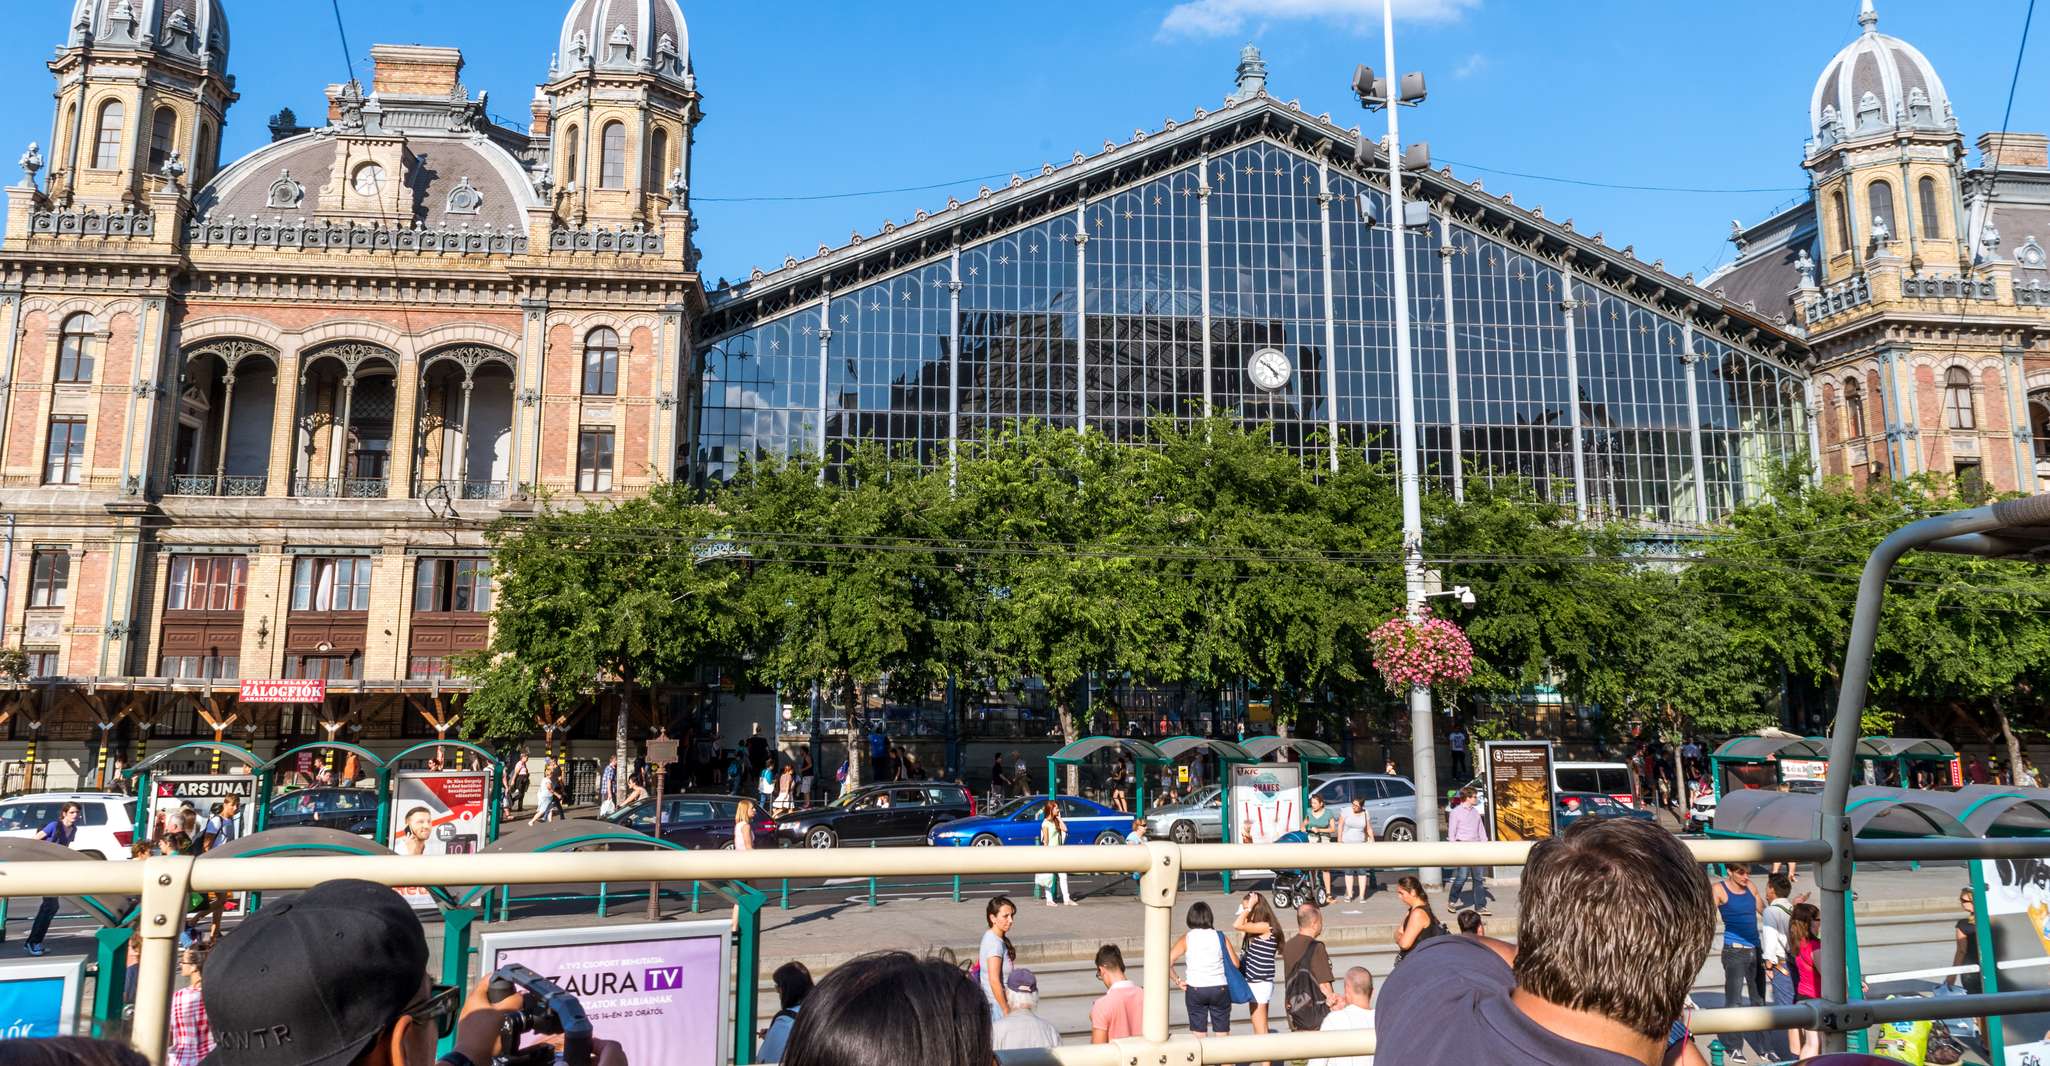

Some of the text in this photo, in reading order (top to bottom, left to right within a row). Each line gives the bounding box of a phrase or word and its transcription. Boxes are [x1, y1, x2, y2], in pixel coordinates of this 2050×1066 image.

[242, 684, 321, 696] ZÁLOGFIÓK
[175, 782, 251, 796] ARS UNA!
[649, 968, 679, 988] TV
